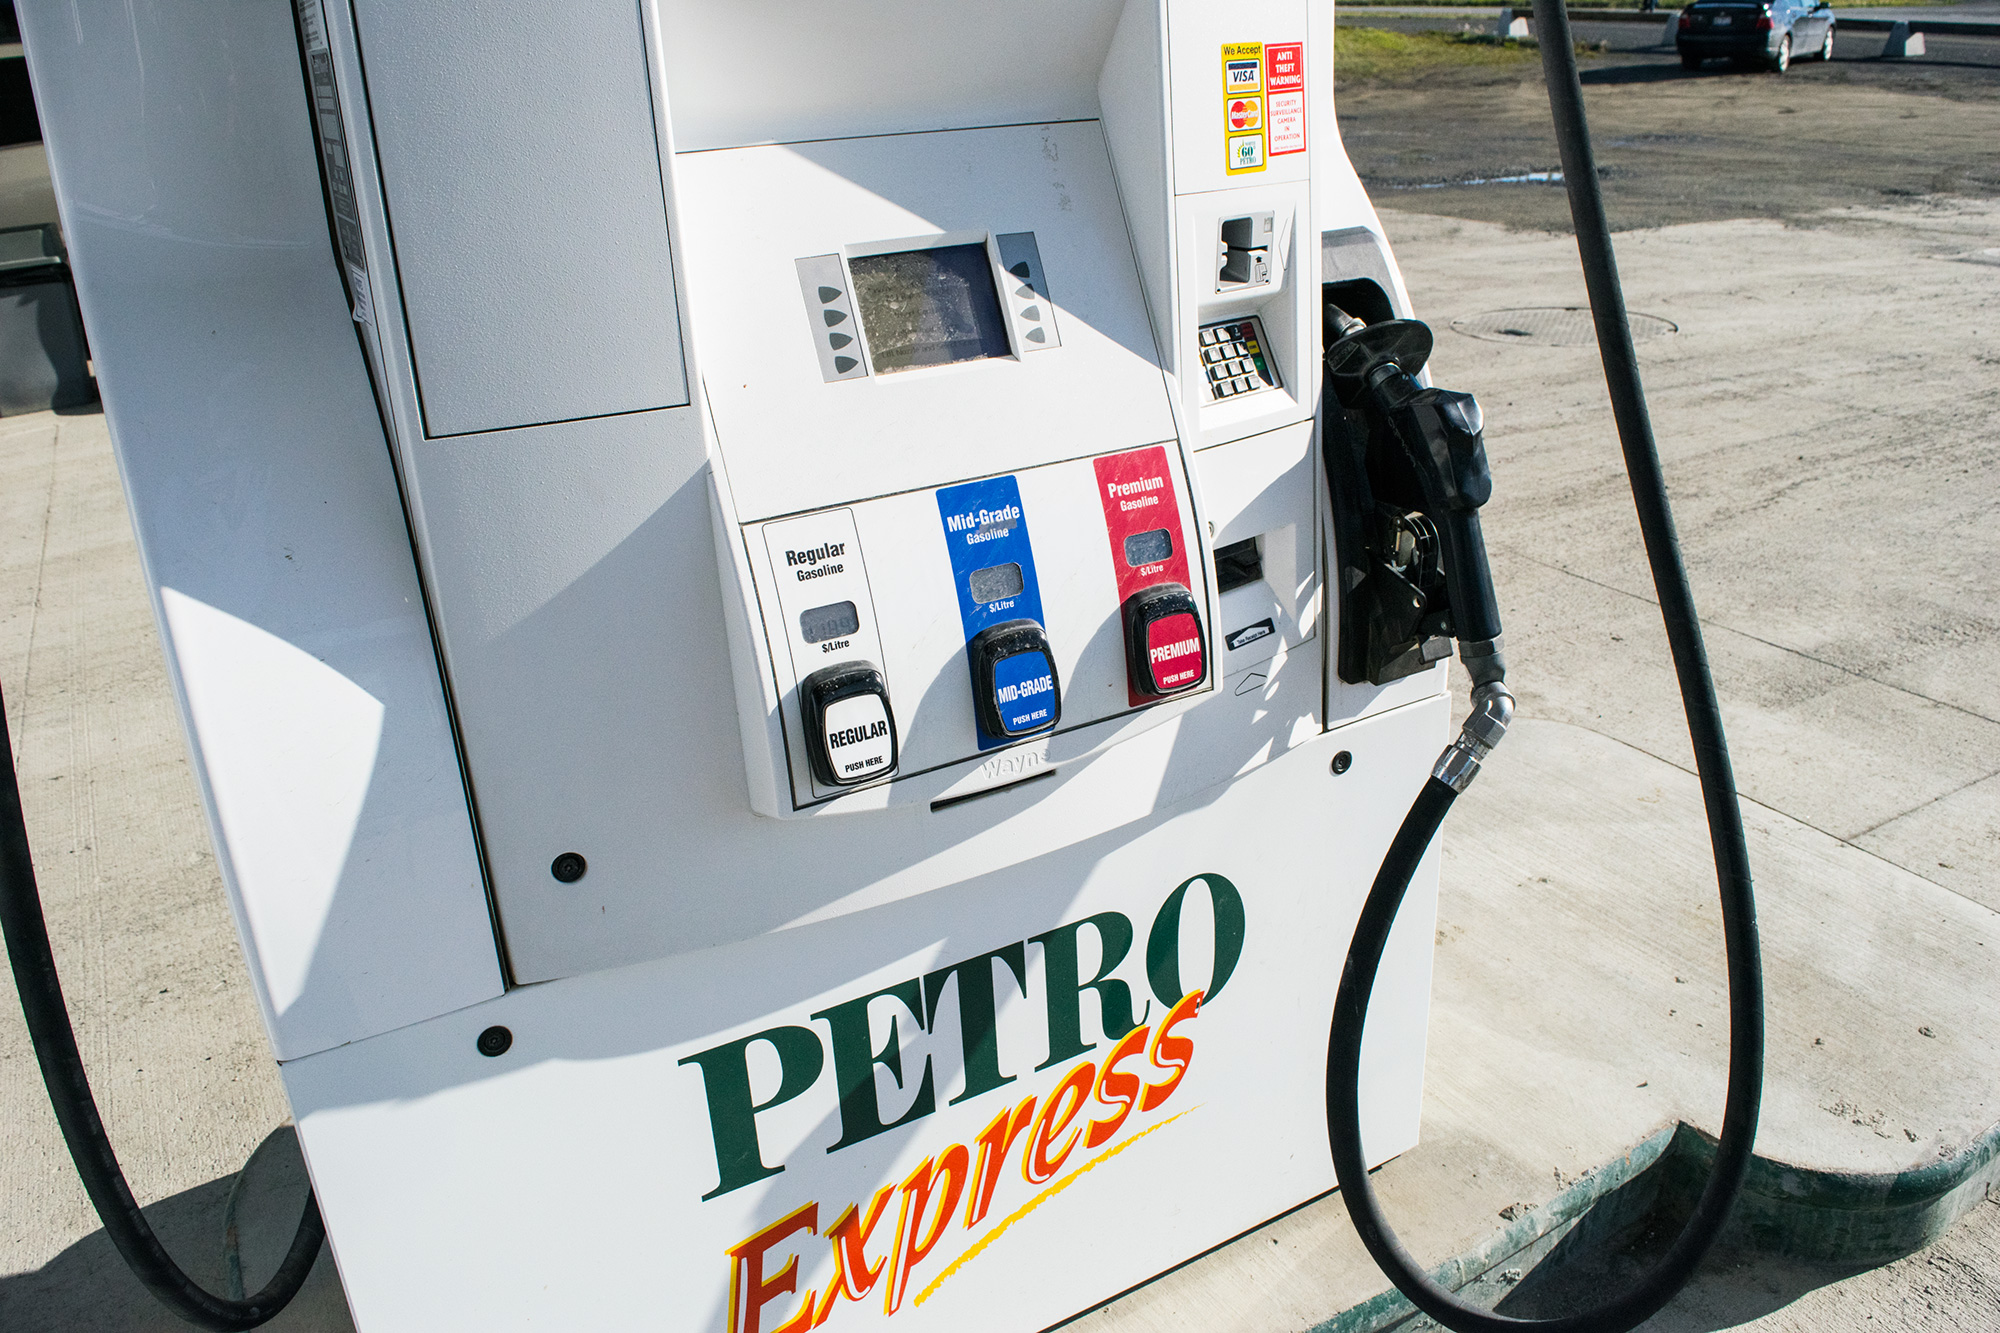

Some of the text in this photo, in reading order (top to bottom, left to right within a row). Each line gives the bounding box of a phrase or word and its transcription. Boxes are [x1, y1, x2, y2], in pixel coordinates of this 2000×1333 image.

[1223, 45, 1261, 55] We Accept
[1277, 51, 1293, 61] ANTI
[1232, 70, 1255, 82] VISA
[1275, 63, 1295, 73] THEFT
[1269, 74, 1301, 86] WARNING
[1270, 107, 1302, 116] SURVEILLANCE
[1275, 99, 1297, 108] SECURITY
[1277, 116, 1296, 124] CAMERA
[1274, 133, 1301, 142] OPERATION
[1107, 476, 1164, 498] Premium
[1120, 495, 1158, 511] Gasoline
[947, 504, 1020, 532] Mid-Grade
[966, 527, 1009, 545] Gasoline
[785, 541, 846, 568] Regular
[796, 562, 844, 582] Gasoline
[1140, 564, 1164, 577] $/Litre
[989, 600, 1015, 614] $/Litre
[821, 638, 850, 653] $/Litre
[1150, 637, 1200, 664] PREMIUM
[1163, 669, 1195, 685] PUSH HERE
[997, 674, 1053, 705] MID-GRADE
[1013, 708, 1047, 726] PUSH HERE
[829, 720, 888, 750] REGULAR
[845, 755, 884, 773] PUSH HERE
[677, 872, 1245, 1202] PETRO
[724, 989, 1205, 1333] Express
